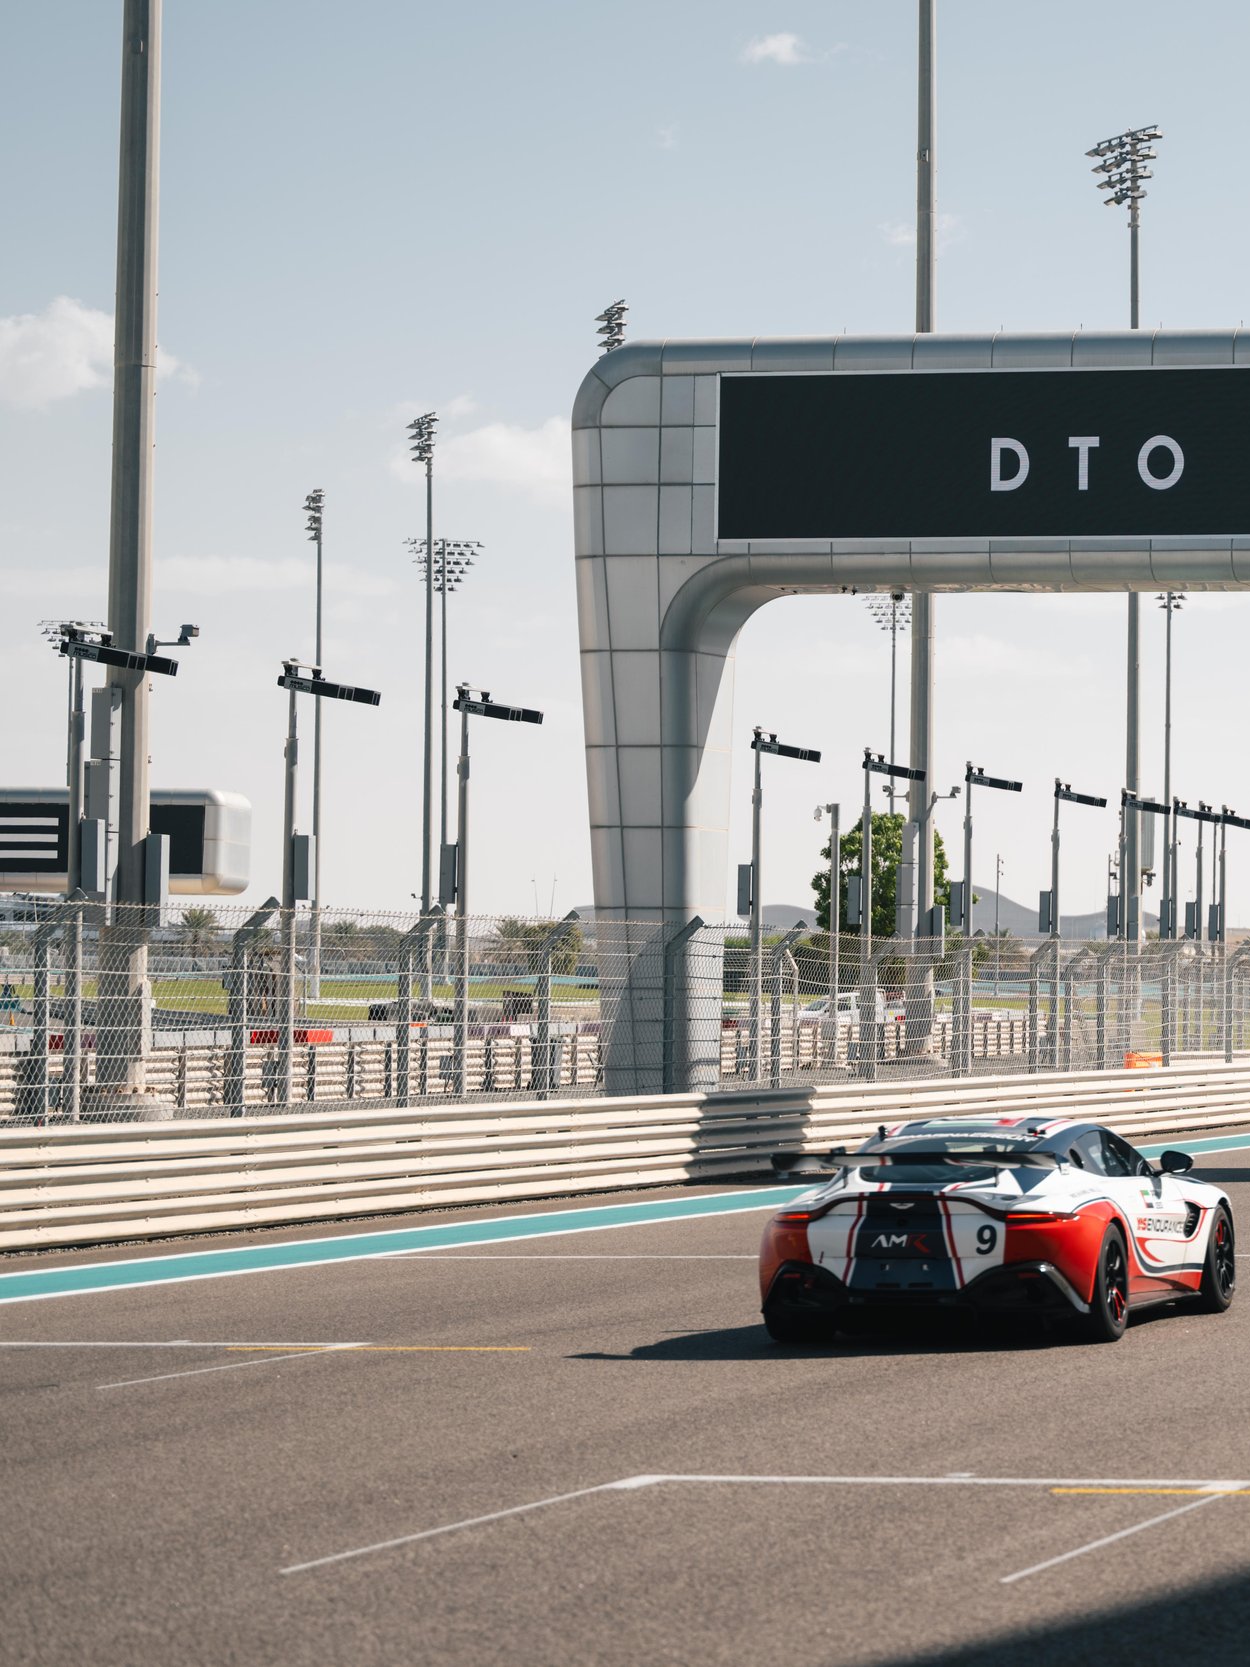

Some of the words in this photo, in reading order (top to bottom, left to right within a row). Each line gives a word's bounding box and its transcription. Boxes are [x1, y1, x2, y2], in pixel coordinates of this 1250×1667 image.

[990, 434, 1185, 492] DTO
[871, 1234, 931, 1254] AMR
[975, 1223, 998, 1256] 9
